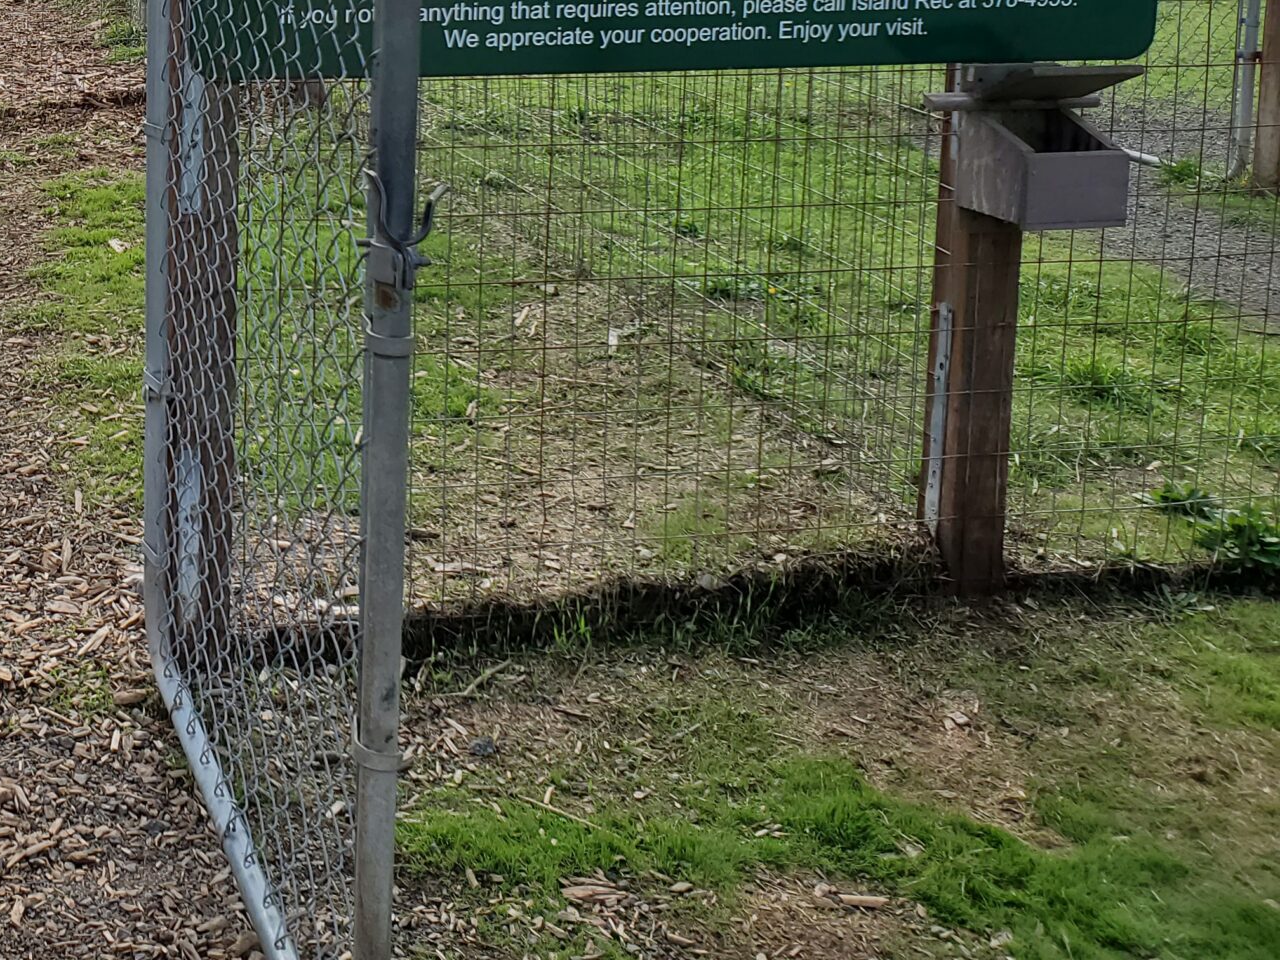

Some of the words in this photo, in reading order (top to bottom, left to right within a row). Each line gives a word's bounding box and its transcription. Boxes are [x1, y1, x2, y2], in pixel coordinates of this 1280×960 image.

[419, 2, 503, 25] anything
[510, 1, 550, 19] that
[556, 0, 638, 21] requires
[443, 29, 479, 47] We
[485, 27, 593, 50] appreciate
[599, 29, 645, 48] your
[650, 22, 771, 45] cooperation.
[778, 20, 833, 42] Enjoy
[837, 22, 881, 41] your
[885, 17, 927, 35] visit.
